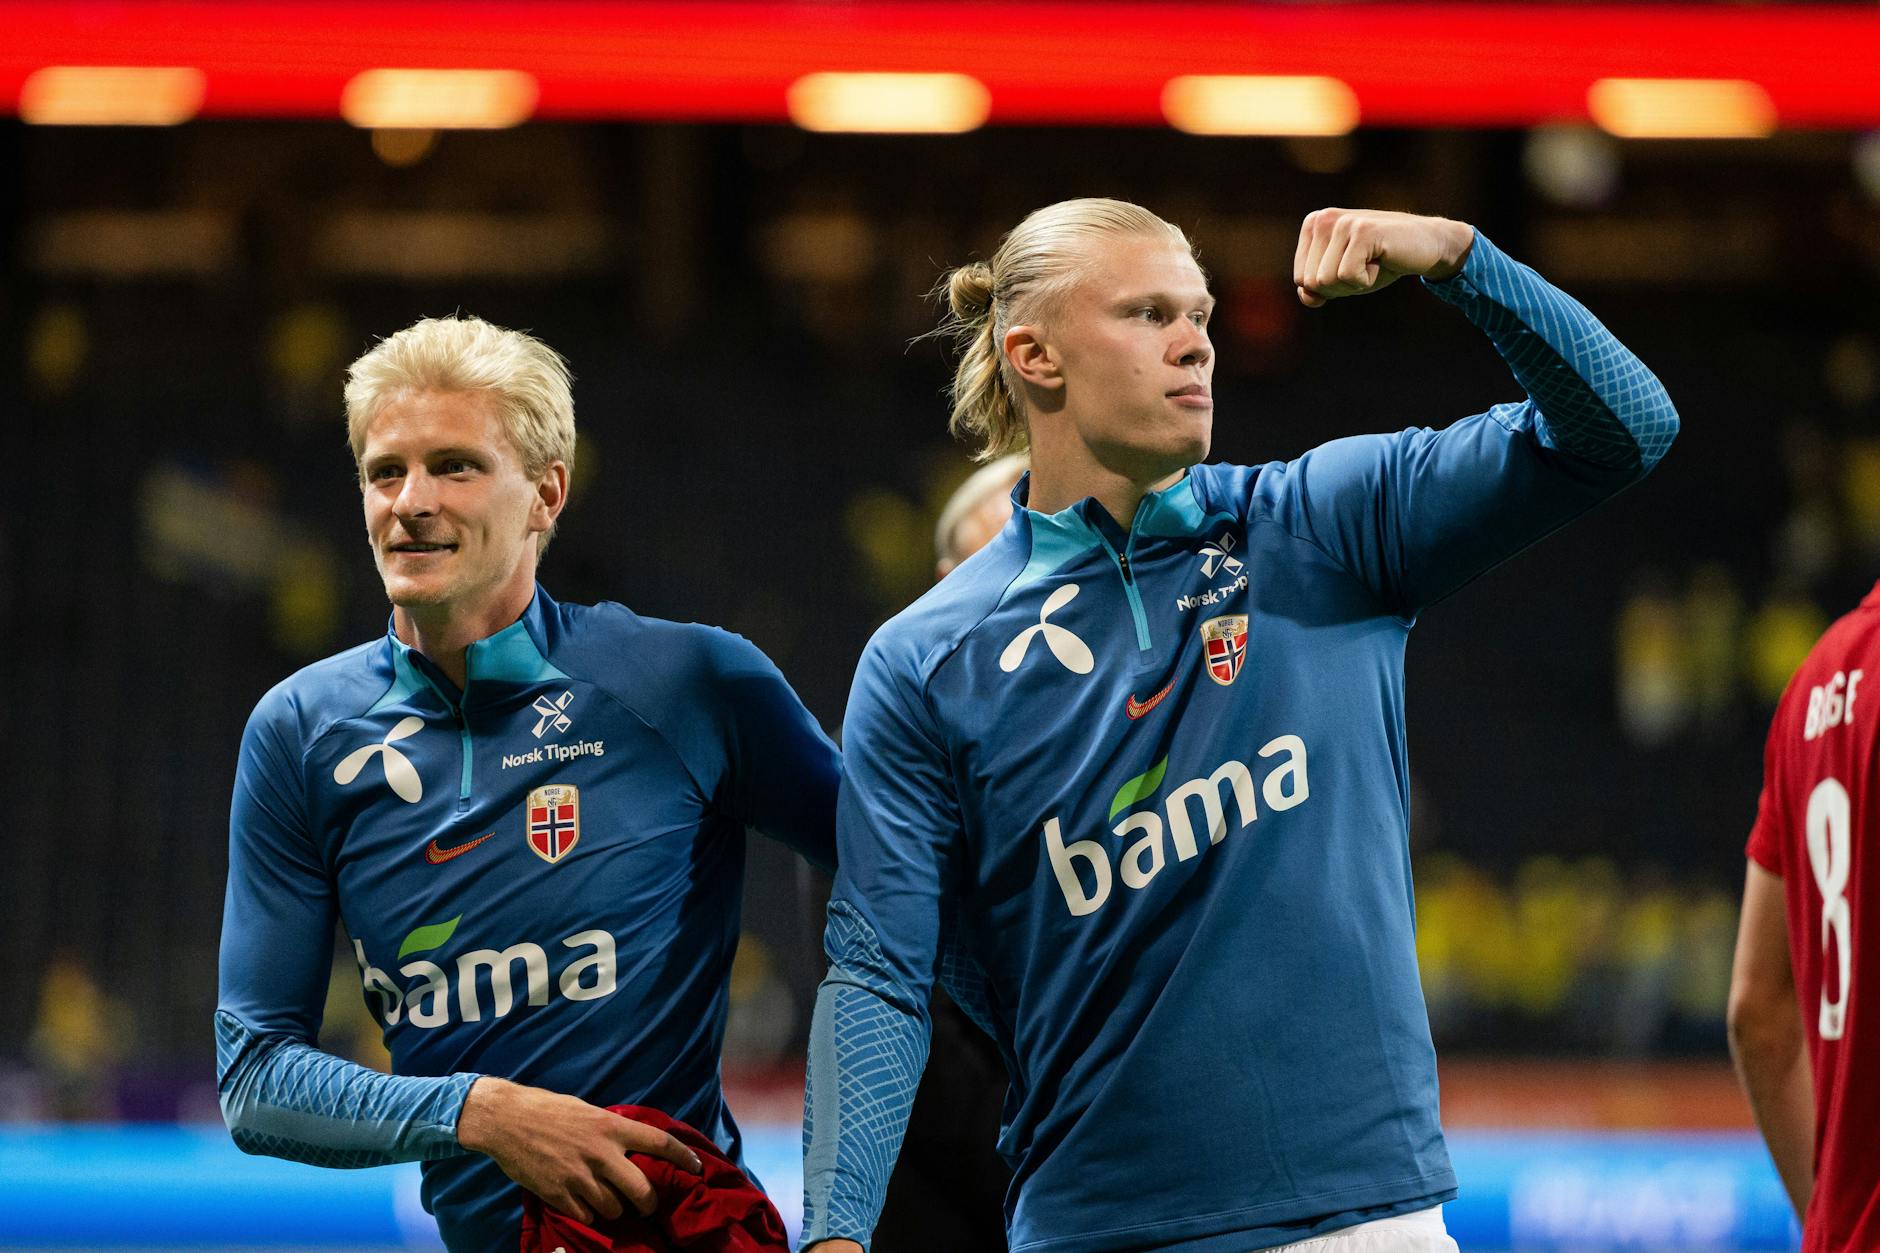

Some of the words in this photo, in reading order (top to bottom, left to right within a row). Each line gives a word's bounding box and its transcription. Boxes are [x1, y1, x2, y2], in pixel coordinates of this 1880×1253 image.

[1176, 589, 1220, 611] Norsk
[502, 748, 543, 770] Norsk
[544, 740, 604, 762] Tipping
[1043, 734, 1310, 917] bama
[1805, 777, 1852, 1040] 8
[353, 930, 617, 1029] bama
